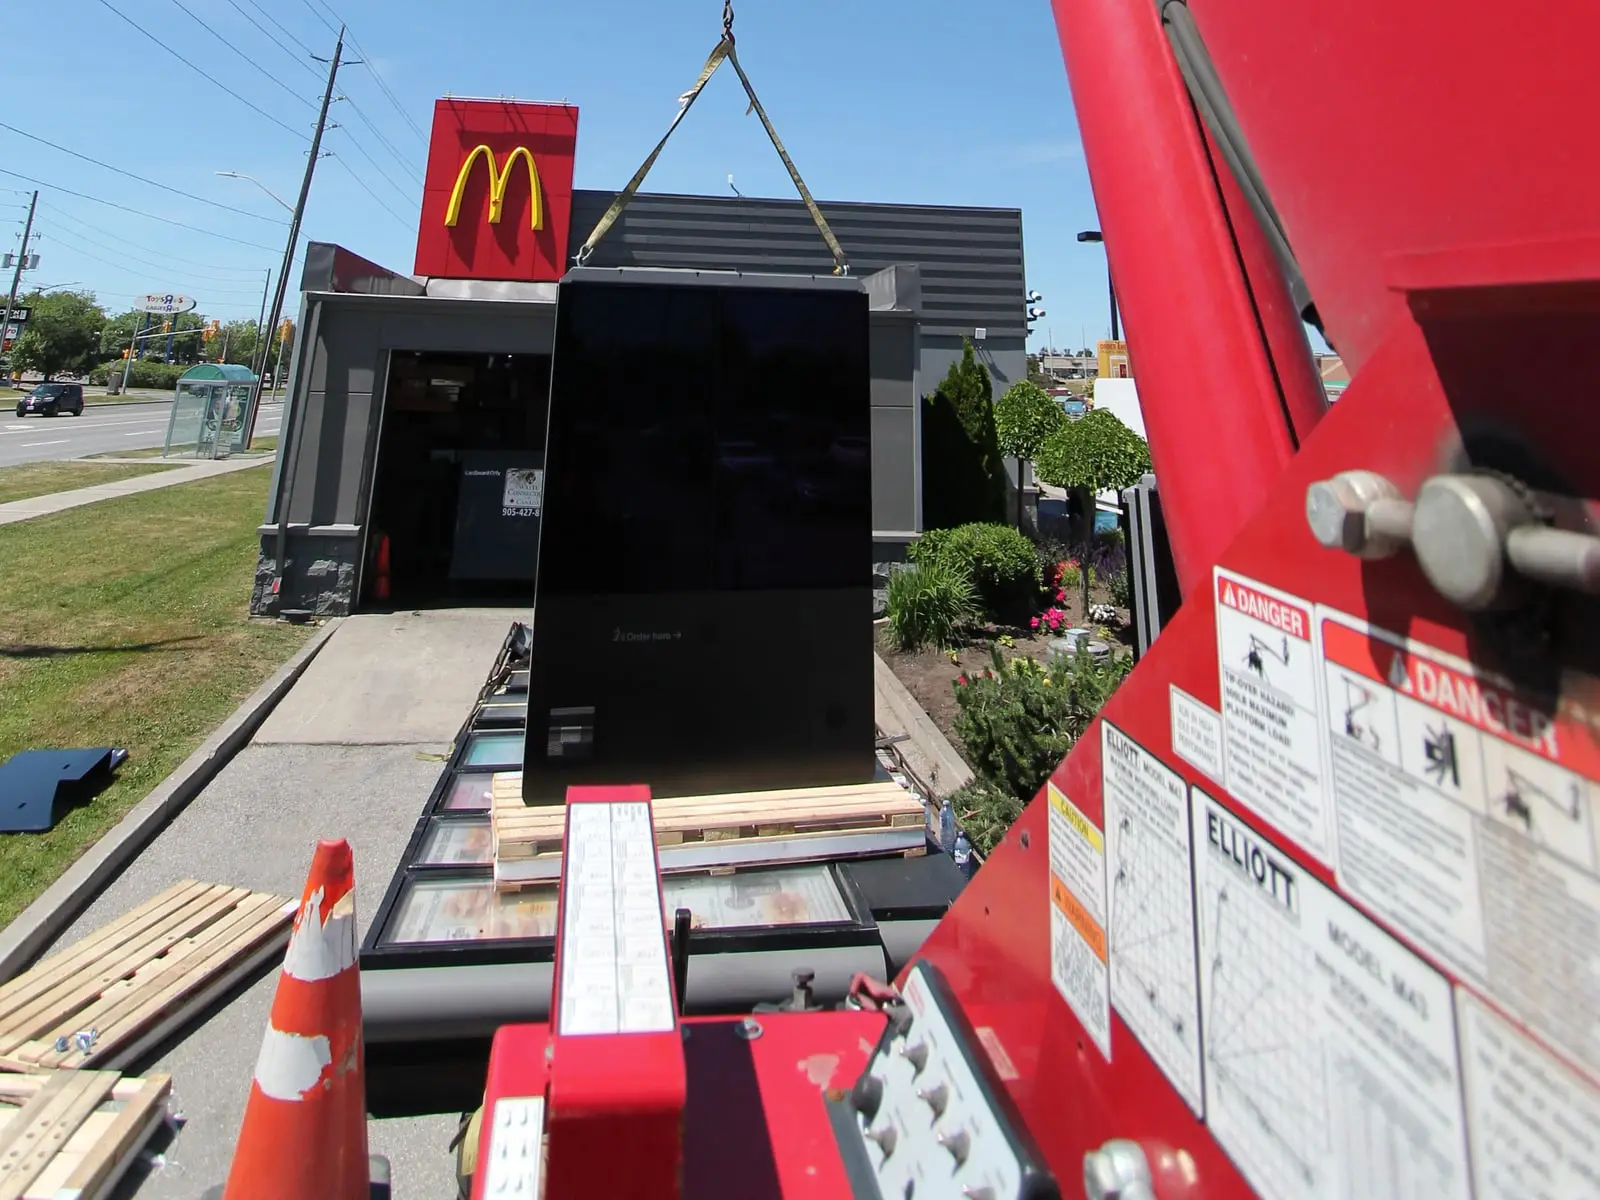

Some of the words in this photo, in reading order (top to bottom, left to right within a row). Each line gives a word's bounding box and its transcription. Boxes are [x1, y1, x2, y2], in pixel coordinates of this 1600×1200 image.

[1237, 586, 1304, 638] DANGER
[1415, 661, 1560, 759] DANGER
[1106, 727, 1140, 767] ELLIOTT
[1060, 799, 1089, 838] CAUTION
[1207, 807, 1294, 908] ELLIOTT
